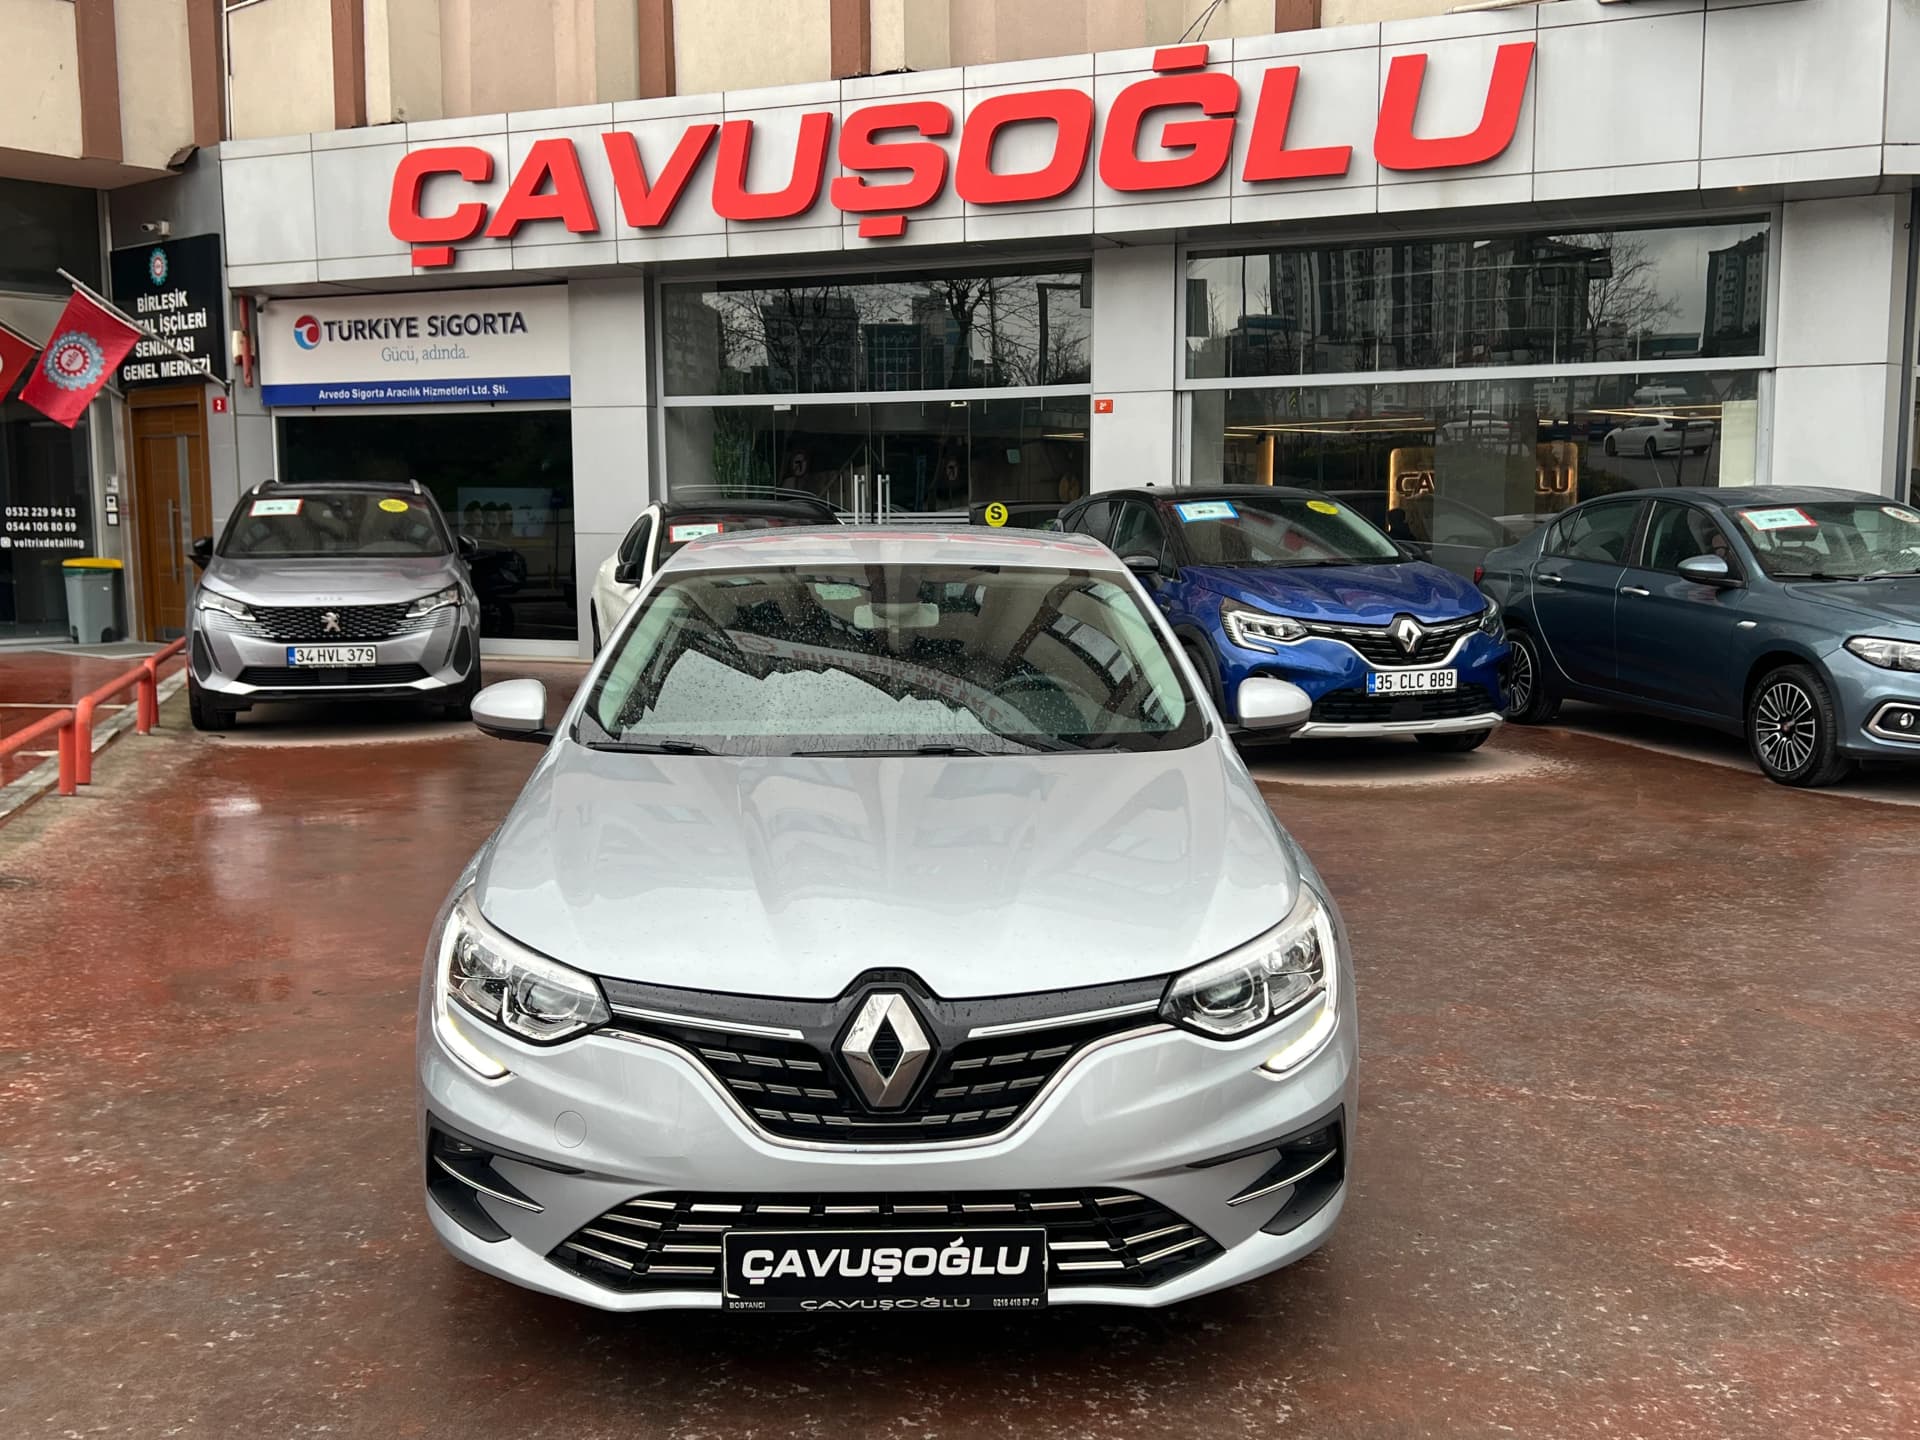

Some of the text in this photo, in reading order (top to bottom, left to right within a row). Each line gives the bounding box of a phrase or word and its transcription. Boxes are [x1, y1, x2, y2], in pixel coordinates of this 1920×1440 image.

[388, 41, 1536, 267] ÇAVUŞOĞLU
[136, 287, 189, 313] BİRLEŞİK
[159, 307, 207, 336] İŞÇİLERİ
[381, 343, 470, 363] Gücü, adında.
[123, 362, 159, 381] GENEL
[319, 383, 509, 400] Arvedo Sigorta Aracılık Hizmetleri Ltd. Şti.
[216, 401, 222, 411] 2
[5, 506, 76, 518] 0532 229 94 53
[5, 521, 77, 532] 0544 106 80 69
[296, 649, 314, 662] 34
[317, 648, 344, 662] HVL
[347, 648, 374, 661] 379
[1376, 674, 1393, 690] 35
[1400, 673, 1424, 689] CLC
[1430, 672, 1454, 687] 889
[800, 1297, 971, 1311] ÇAVUŞOĞLU
